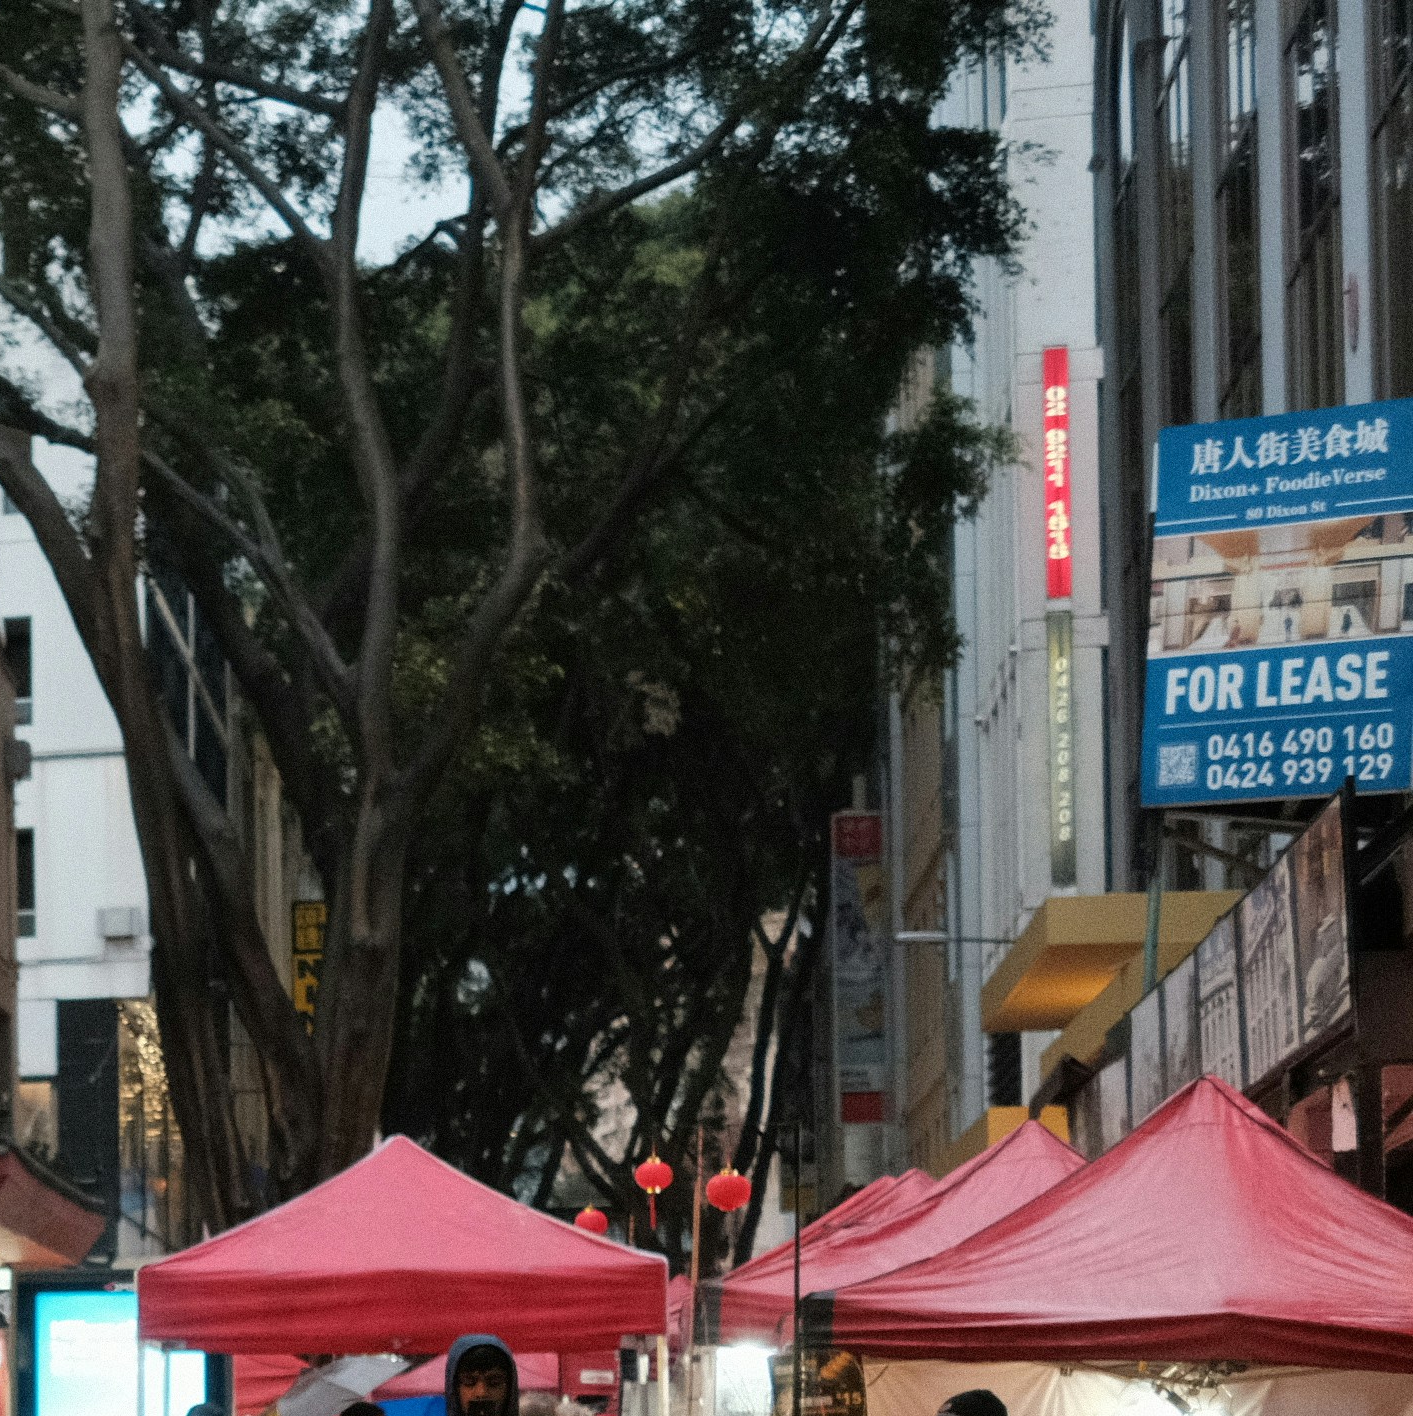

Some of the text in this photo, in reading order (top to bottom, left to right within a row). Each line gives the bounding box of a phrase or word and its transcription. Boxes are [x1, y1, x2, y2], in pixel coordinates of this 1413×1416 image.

[1191, 418, 1390, 476] 唐人街美食城
[1264, 466, 1388, 495] FoodieVerse
[1165, 650, 1391, 715] FOR LEASE
[1206, 722, 1394, 761] 0416 490 160
[1206, 752, 1394, 791] 0424 939 129
